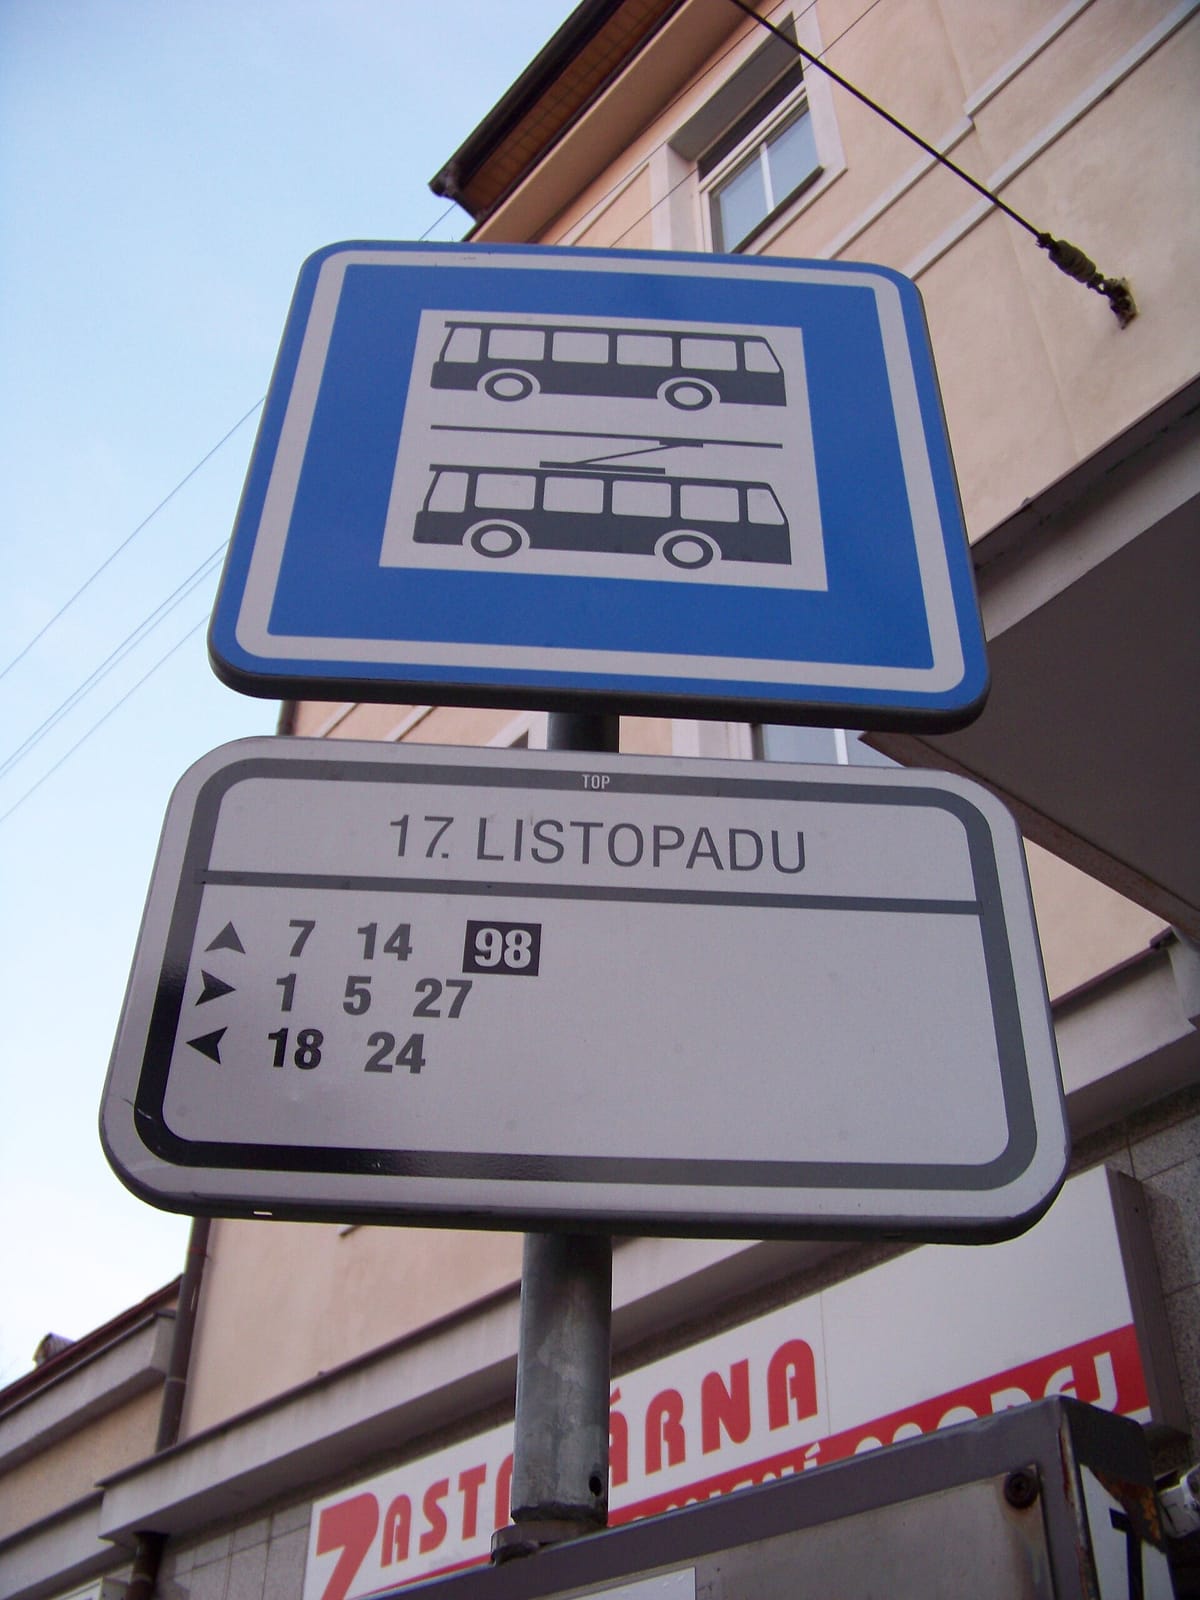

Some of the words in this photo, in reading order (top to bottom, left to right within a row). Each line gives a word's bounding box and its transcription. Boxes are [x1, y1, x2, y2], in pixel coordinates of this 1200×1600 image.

[582, 773, 611, 790] TOP
[390, 815, 454, 859] 17.
[476, 817, 806, 874] LISTOPADU
[288, 919, 316, 957] 7
[357, 922, 413, 961] 14
[474, 927, 532, 969] 98
[275, 973, 297, 1012] 1
[342, 975, 372, 1016] 5
[412, 977, 473, 1019] 27
[267, 1027, 324, 1070] 18
[363, 1031, 426, 1074] 24
